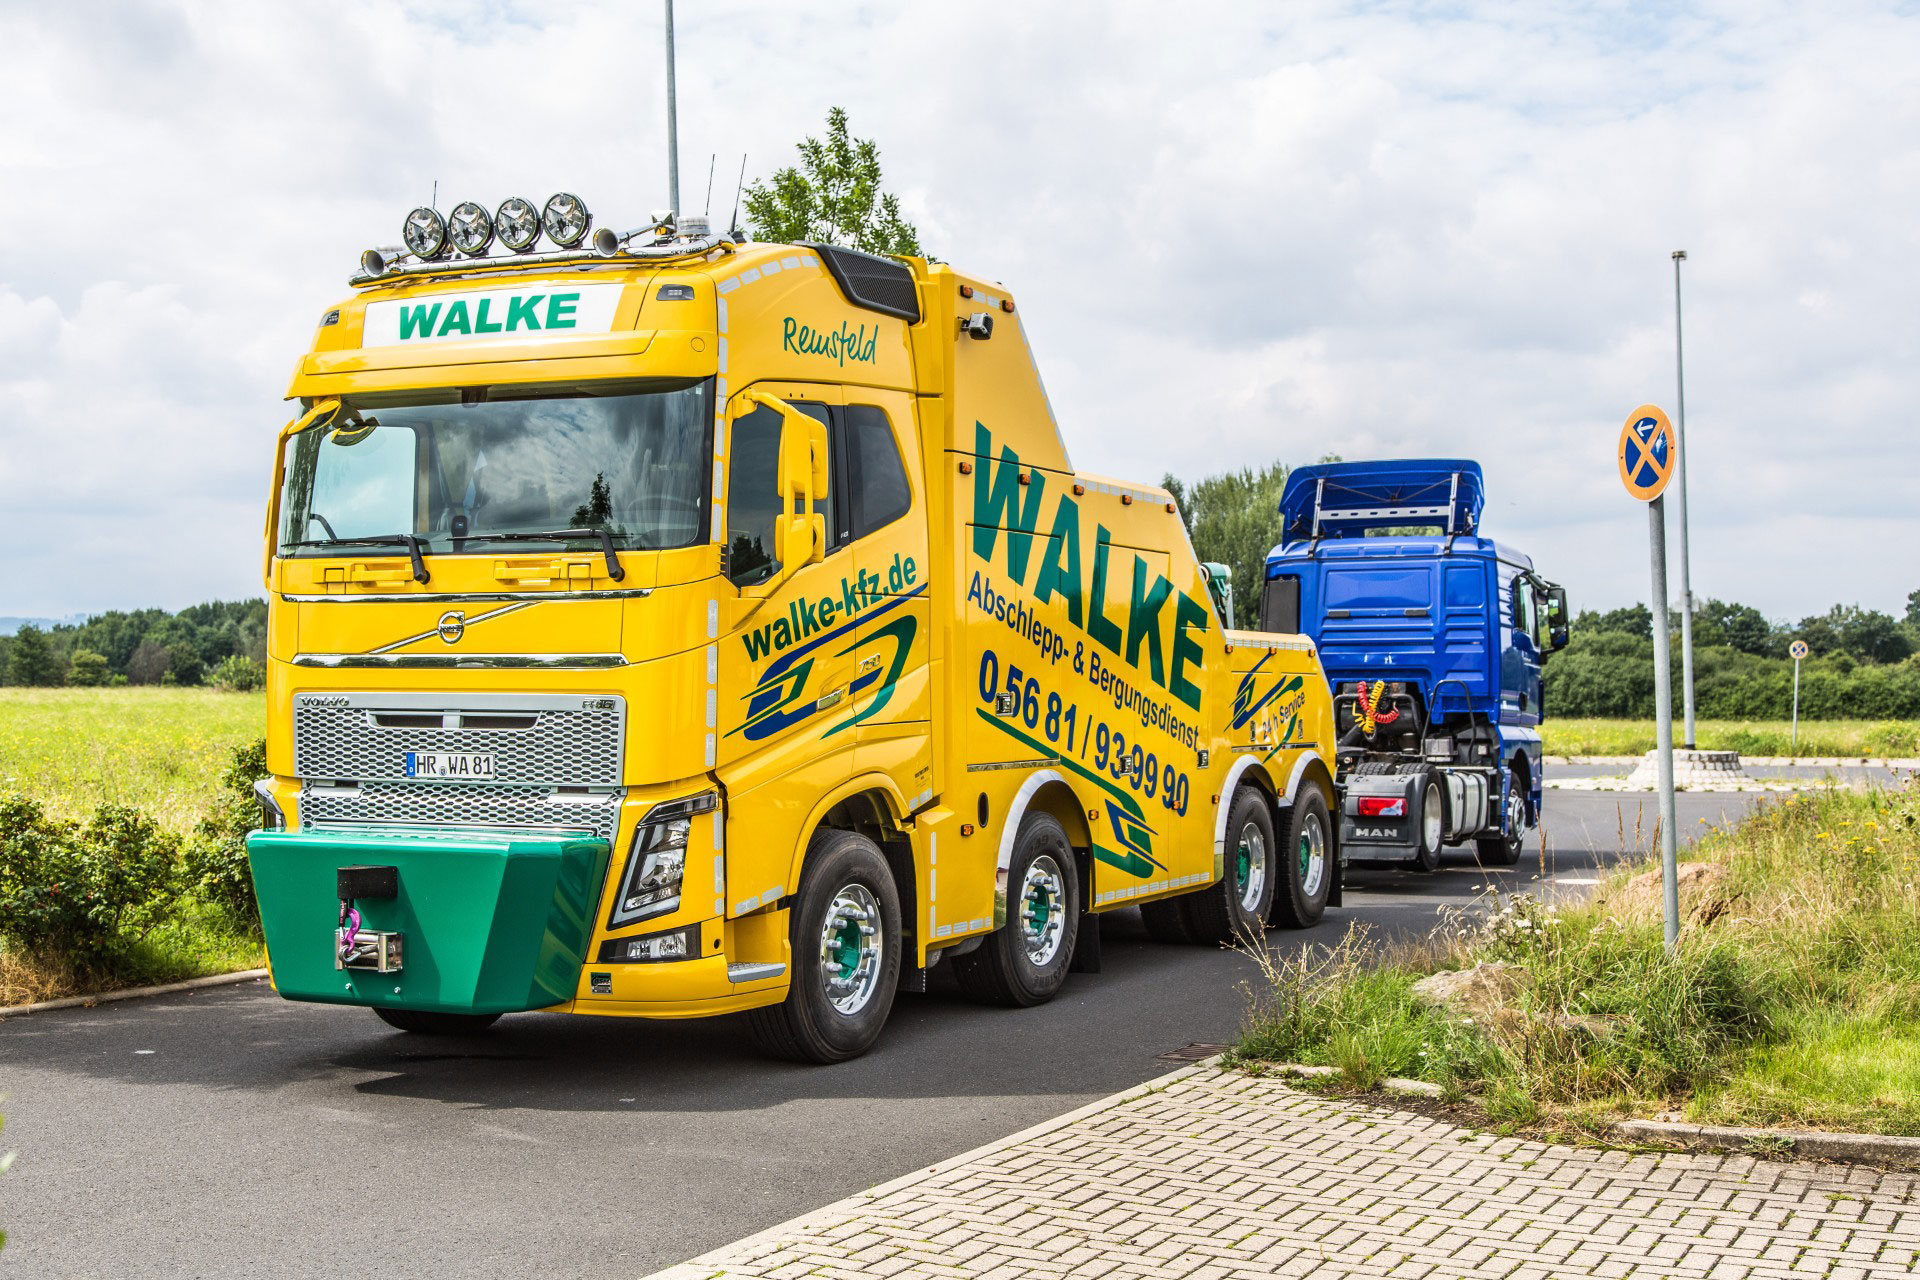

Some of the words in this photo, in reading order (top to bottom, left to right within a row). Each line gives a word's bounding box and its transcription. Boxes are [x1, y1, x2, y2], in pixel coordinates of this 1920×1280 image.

[399, 292, 581, 341] WALKE
[782, 316, 879, 368] Remsfeld
[972, 419, 1209, 713] WALKE
[741, 552, 918, 663] walke-kfz.de
[966, 570, 1069, 666] Abschlepp-
[1073, 640, 1085, 676] &
[1089, 650, 1200, 753] Bergungsdienst
[299, 696, 350, 707] VOLVO
[1262, 717, 1272, 741] 24
[1279, 691, 1306, 725] Service
[416, 755, 437, 774] HR
[448, 756, 470, 775] WA
[473, 756, 493, 776] 81
[1355, 828, 1398, 838] MAN
